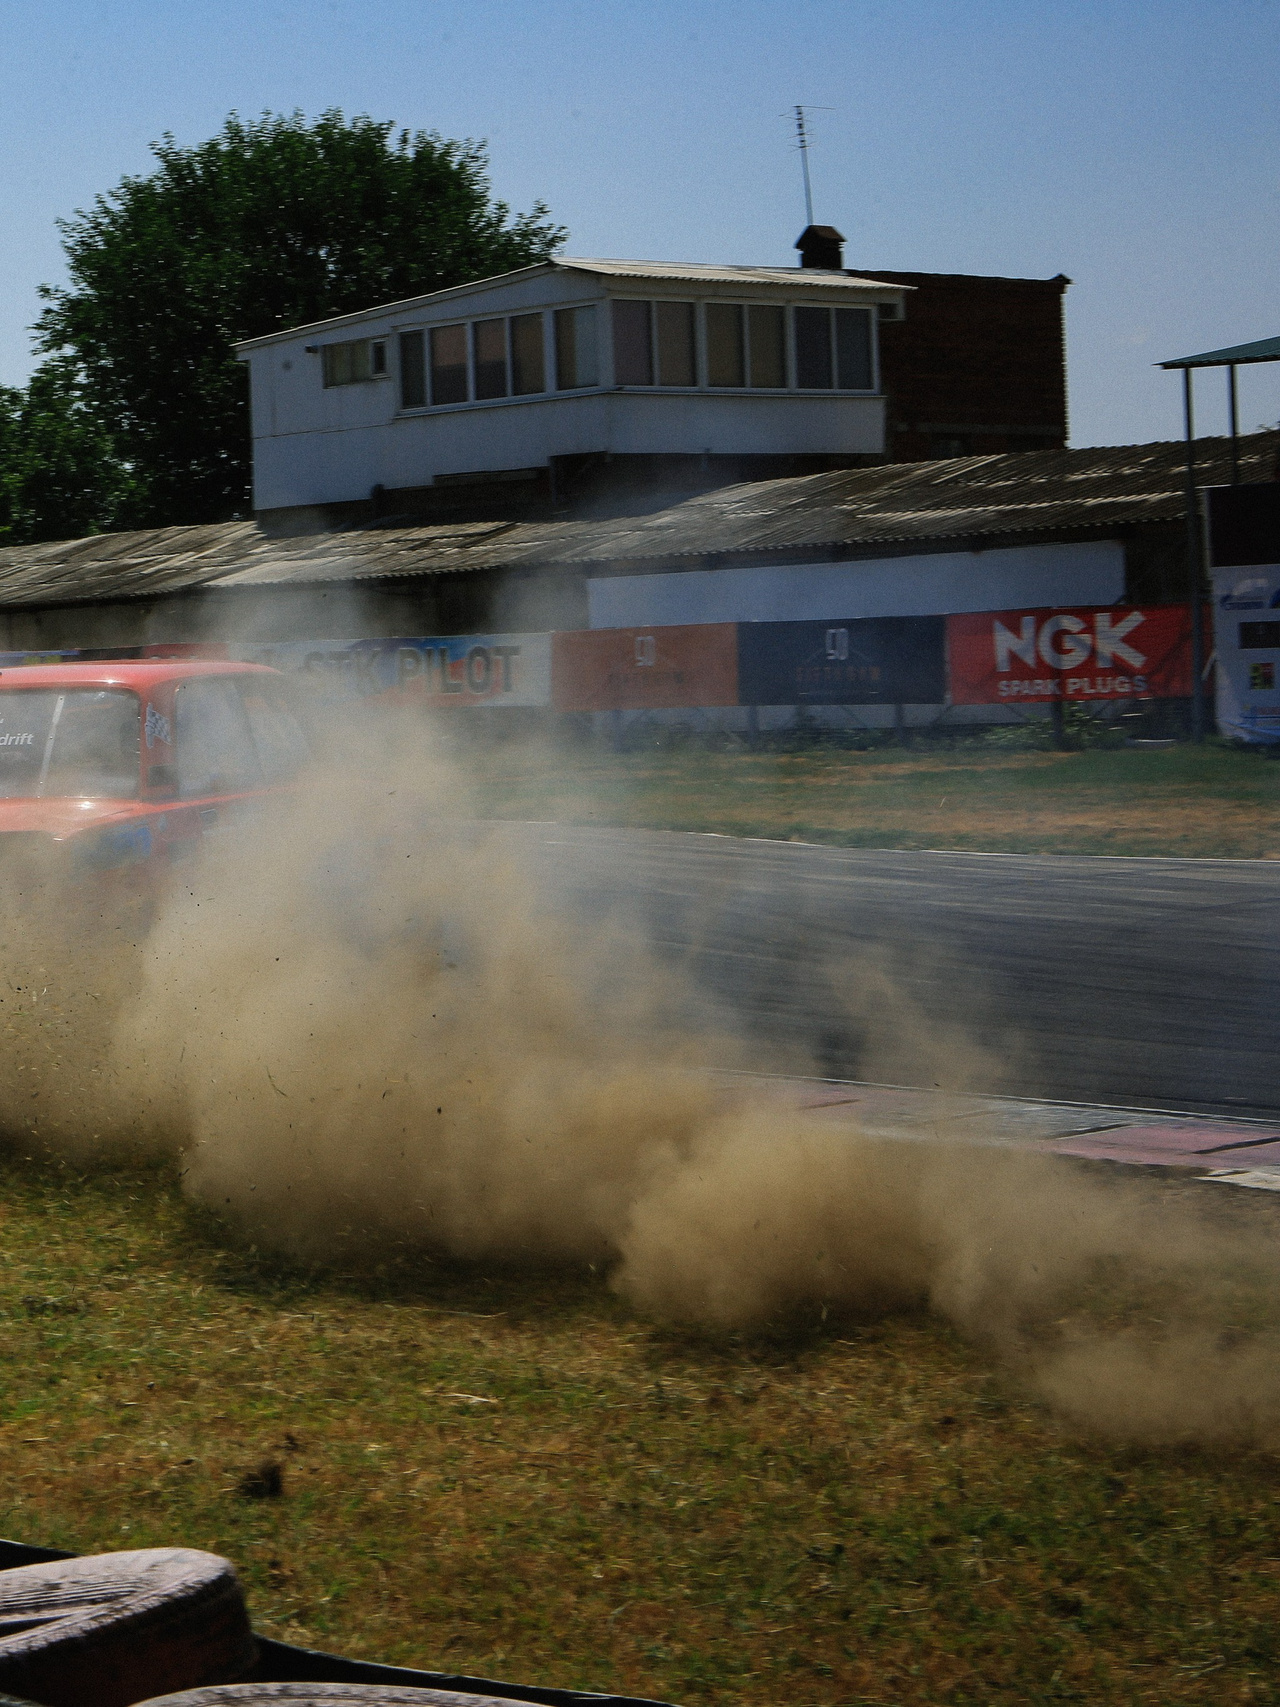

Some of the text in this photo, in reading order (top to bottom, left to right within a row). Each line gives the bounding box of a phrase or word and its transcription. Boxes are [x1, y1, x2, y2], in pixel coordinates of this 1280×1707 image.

[993, 611, 1147, 673] NGK
[398, 645, 521, 694] PILOT
[997, 675, 1148, 697] SPARK PLUGS
